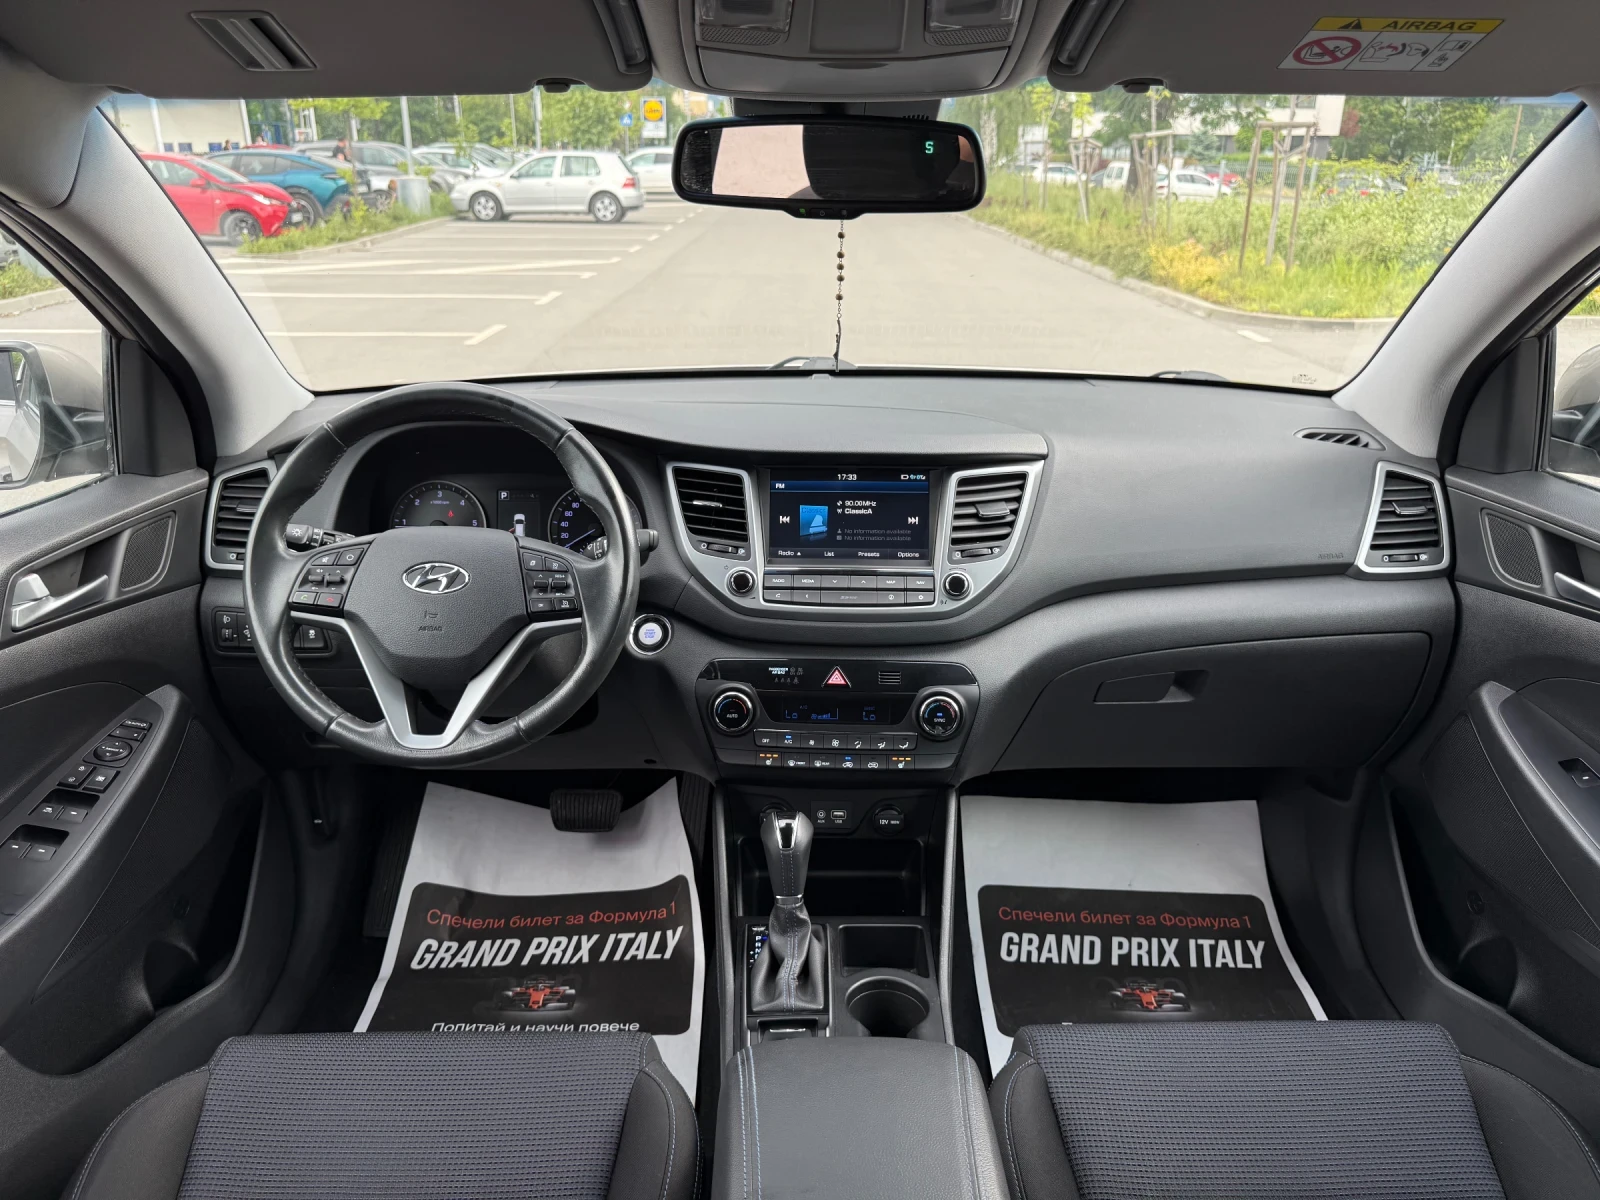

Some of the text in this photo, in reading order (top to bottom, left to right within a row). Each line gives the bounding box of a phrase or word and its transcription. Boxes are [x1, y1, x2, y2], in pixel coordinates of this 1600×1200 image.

[1381, 20, 1477, 31] AIRBAG
[926, 142, 934, 153] S
[427, 901, 676, 929] Спечели билет за Формула 1
[998, 906, 1251, 930] Спечели билет за Формула 1
[410, 925, 684, 970] GRAND PRIX ITALY
[1000, 931, 1265, 969] GRAND PRIX ITALY
[431, 1022, 506, 1032] Попитай
[510, 1024, 521, 1032] и
[578, 1023, 640, 1032] повече
